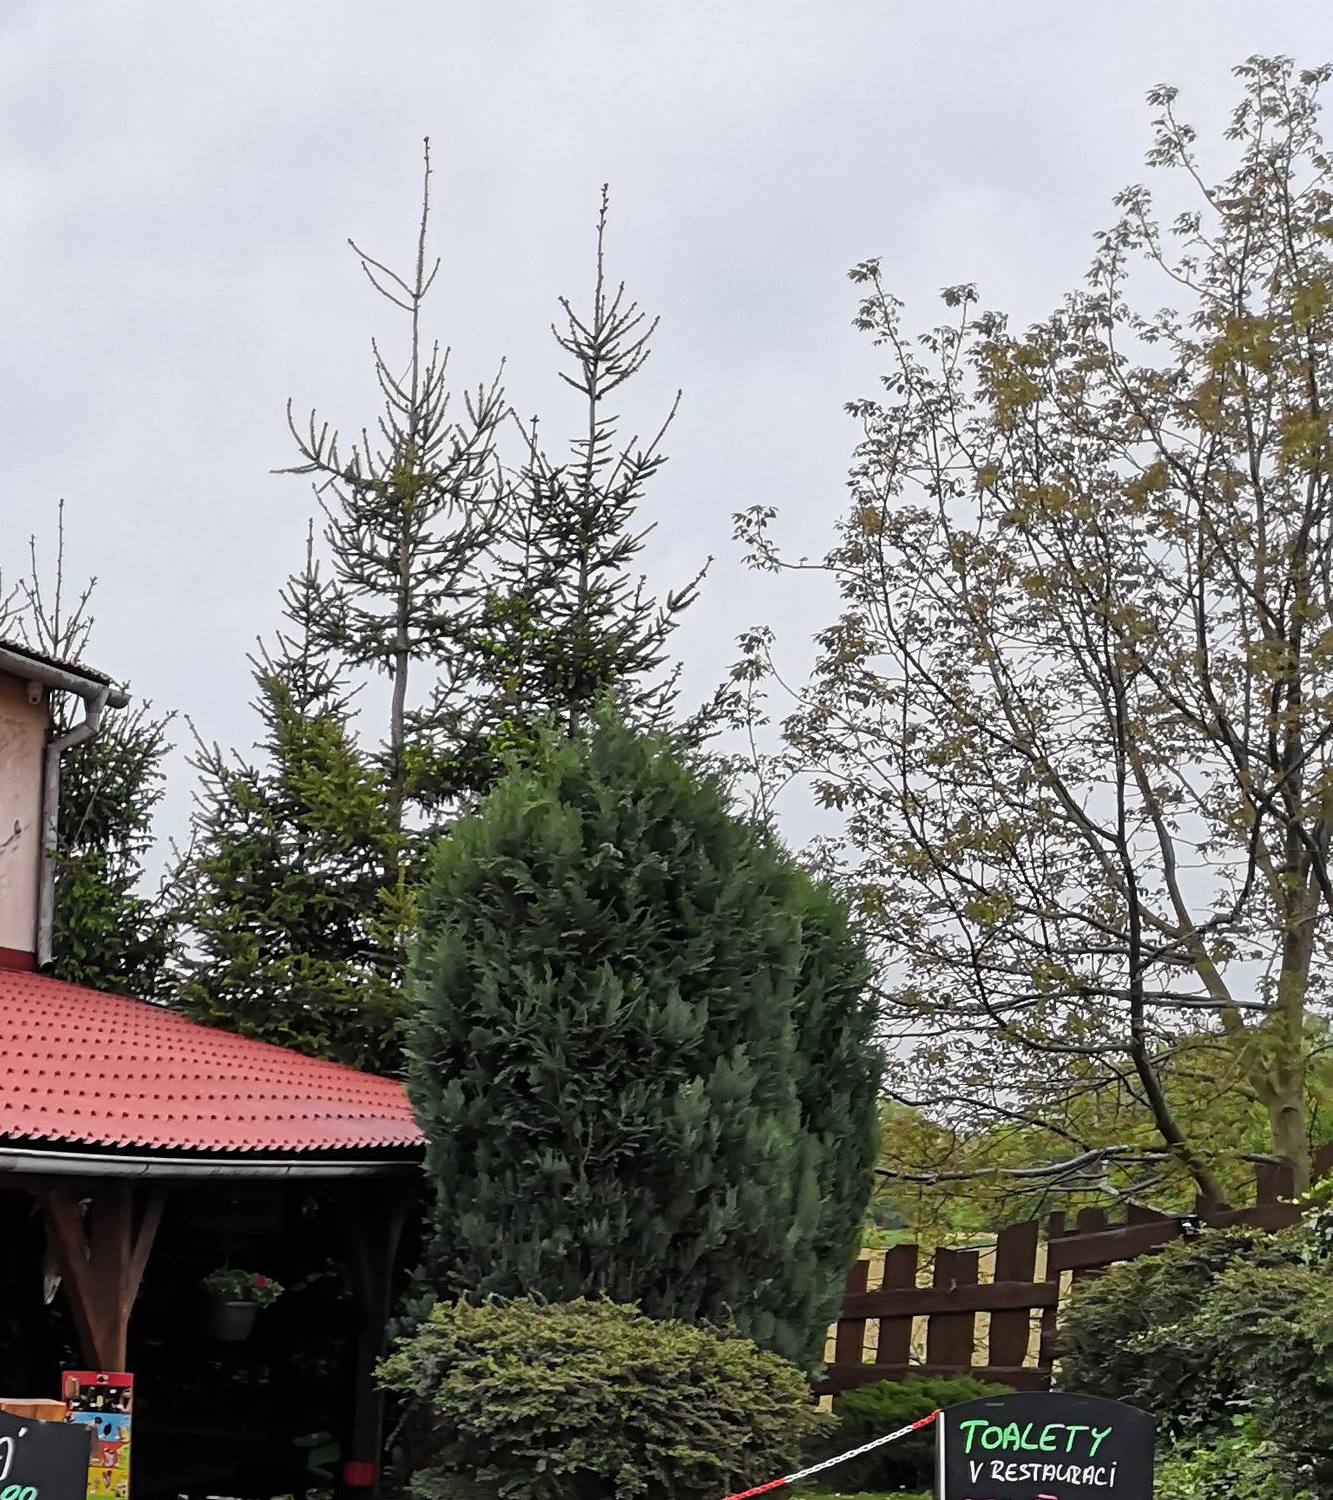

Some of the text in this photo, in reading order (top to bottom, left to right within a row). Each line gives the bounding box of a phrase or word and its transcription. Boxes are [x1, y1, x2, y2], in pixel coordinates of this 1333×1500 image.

[959, 1419, 1113, 1457] TOALETY
[969, 1460, 1117, 1488] V RESTAURACI
